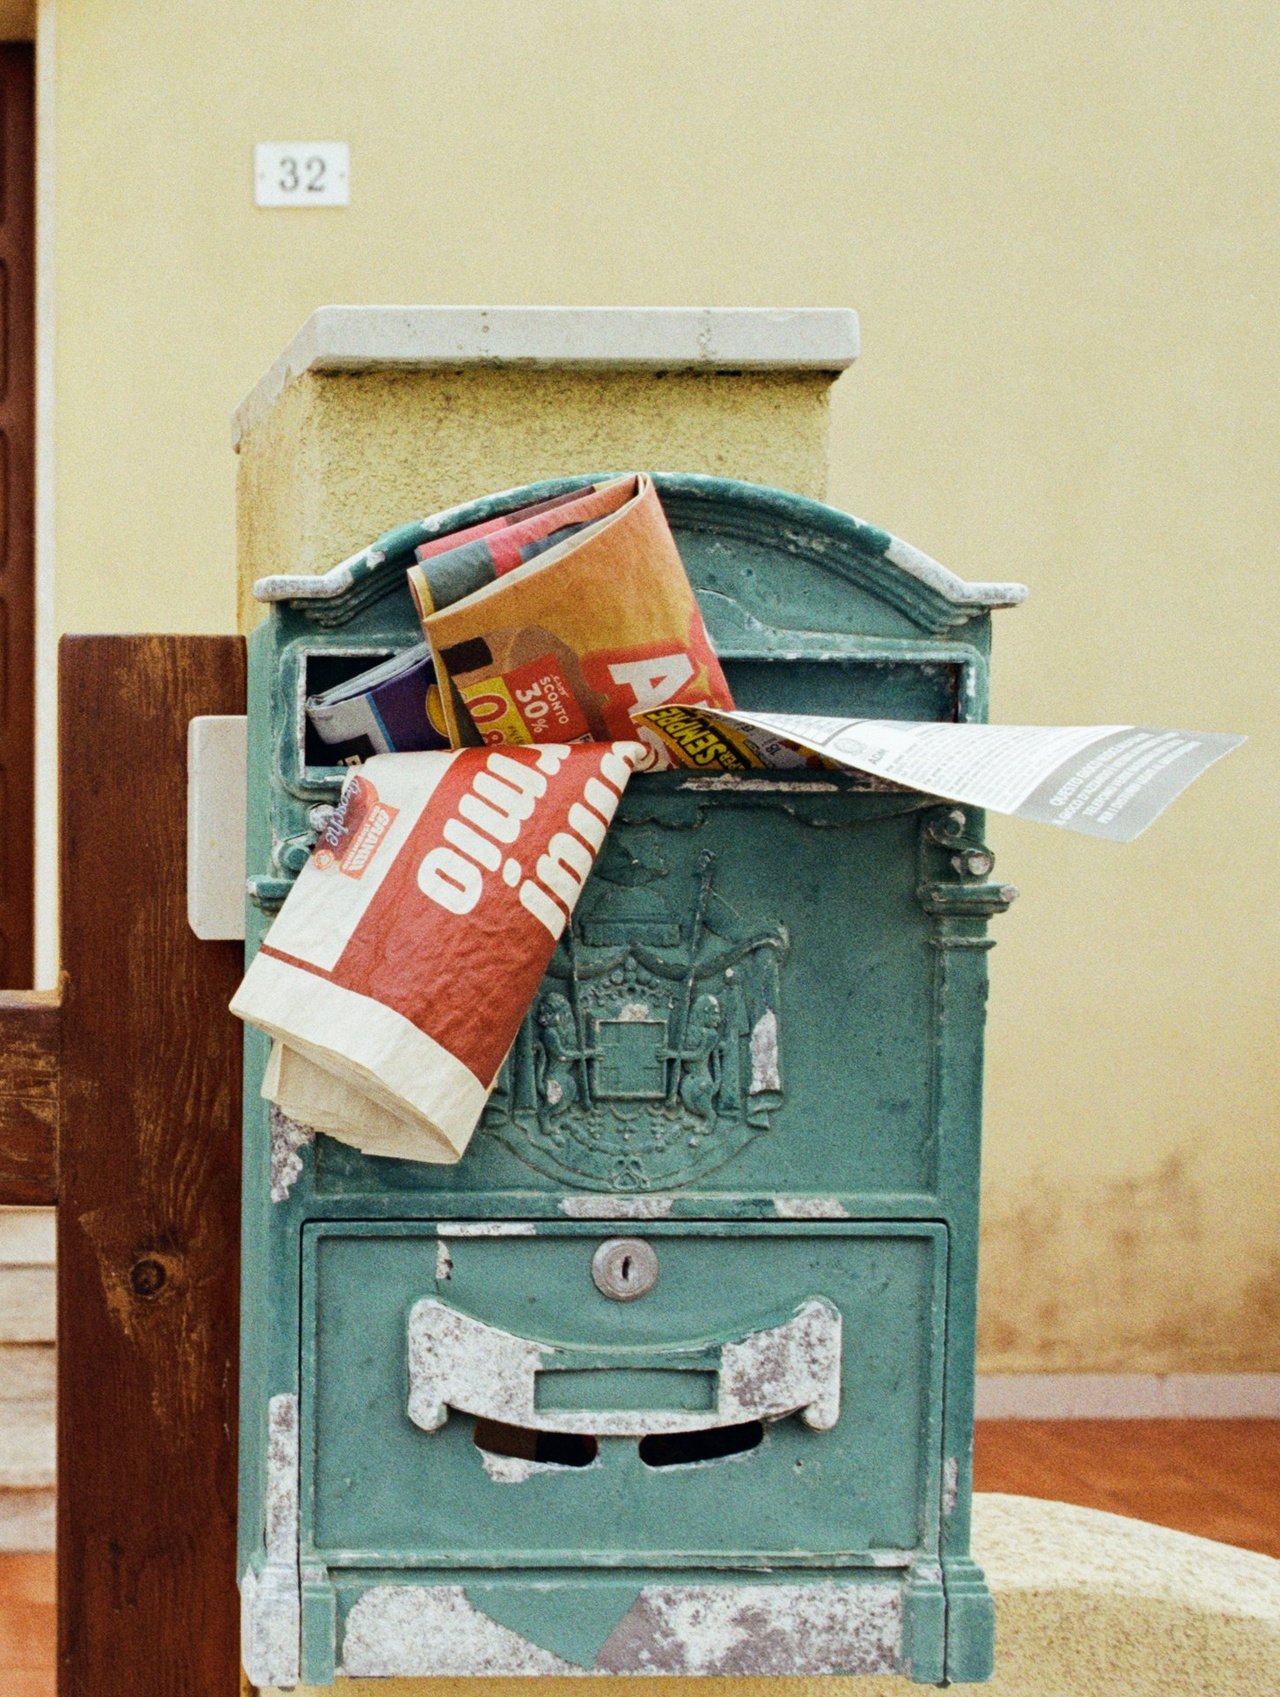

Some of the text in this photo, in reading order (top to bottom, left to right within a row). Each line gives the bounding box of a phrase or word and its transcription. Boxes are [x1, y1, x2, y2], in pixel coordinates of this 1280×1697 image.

[279, 156, 326, 192] 32
[514, 680, 551, 734] 30%
[539, 675, 569, 725] SCONTO
[646, 707, 728, 765] SEMPRE
